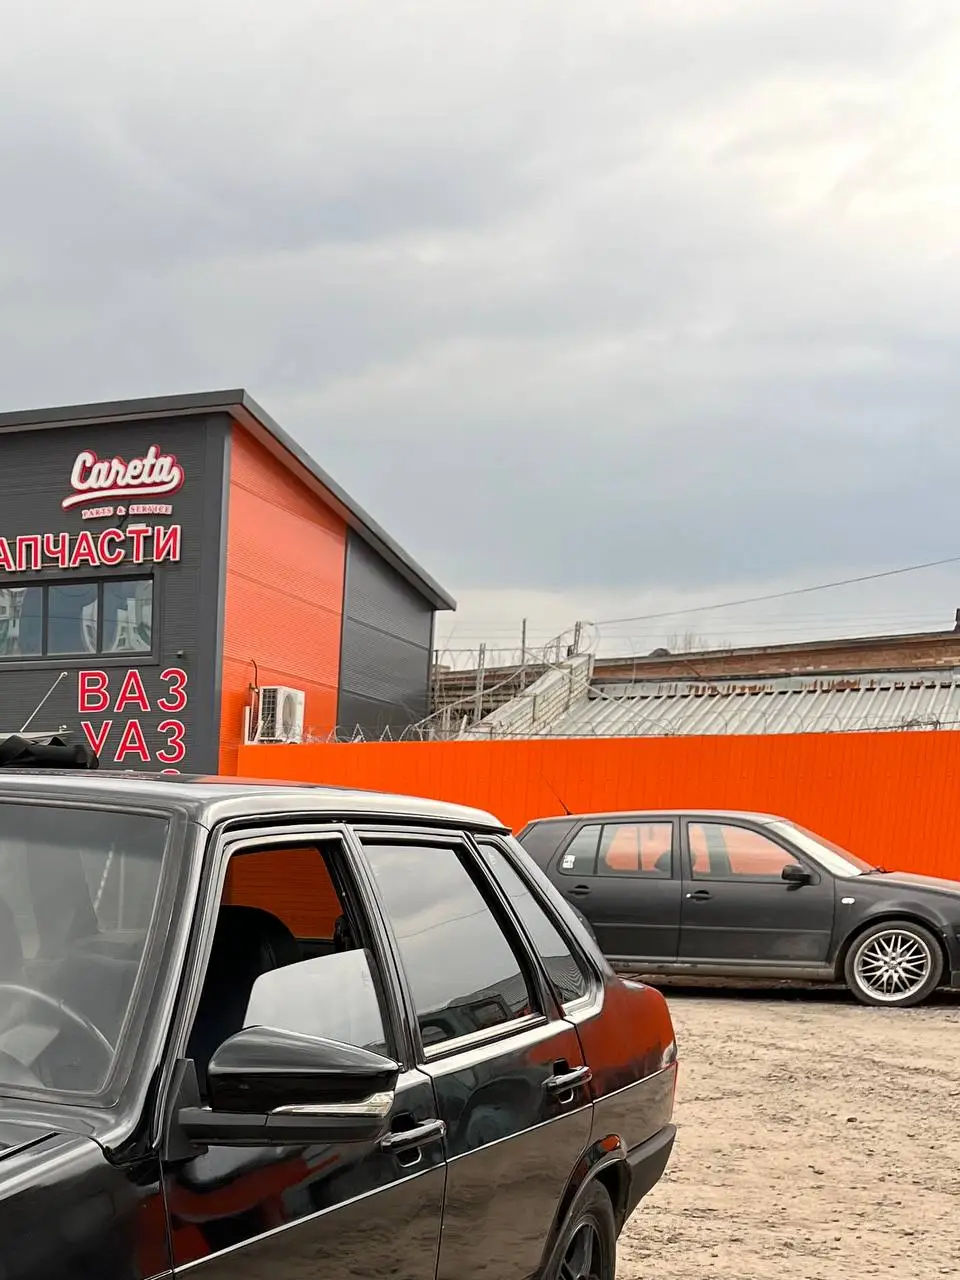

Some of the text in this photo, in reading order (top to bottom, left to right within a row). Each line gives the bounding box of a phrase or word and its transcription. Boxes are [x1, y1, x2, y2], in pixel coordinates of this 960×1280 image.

[68, 444, 182, 498] Careta
[82, 507, 113, 519] PARTS
[129, 504, 172, 515] SERVICE
[78, 668, 188, 713] ВАЗ
[80, 719, 186, 764] УАЗ
